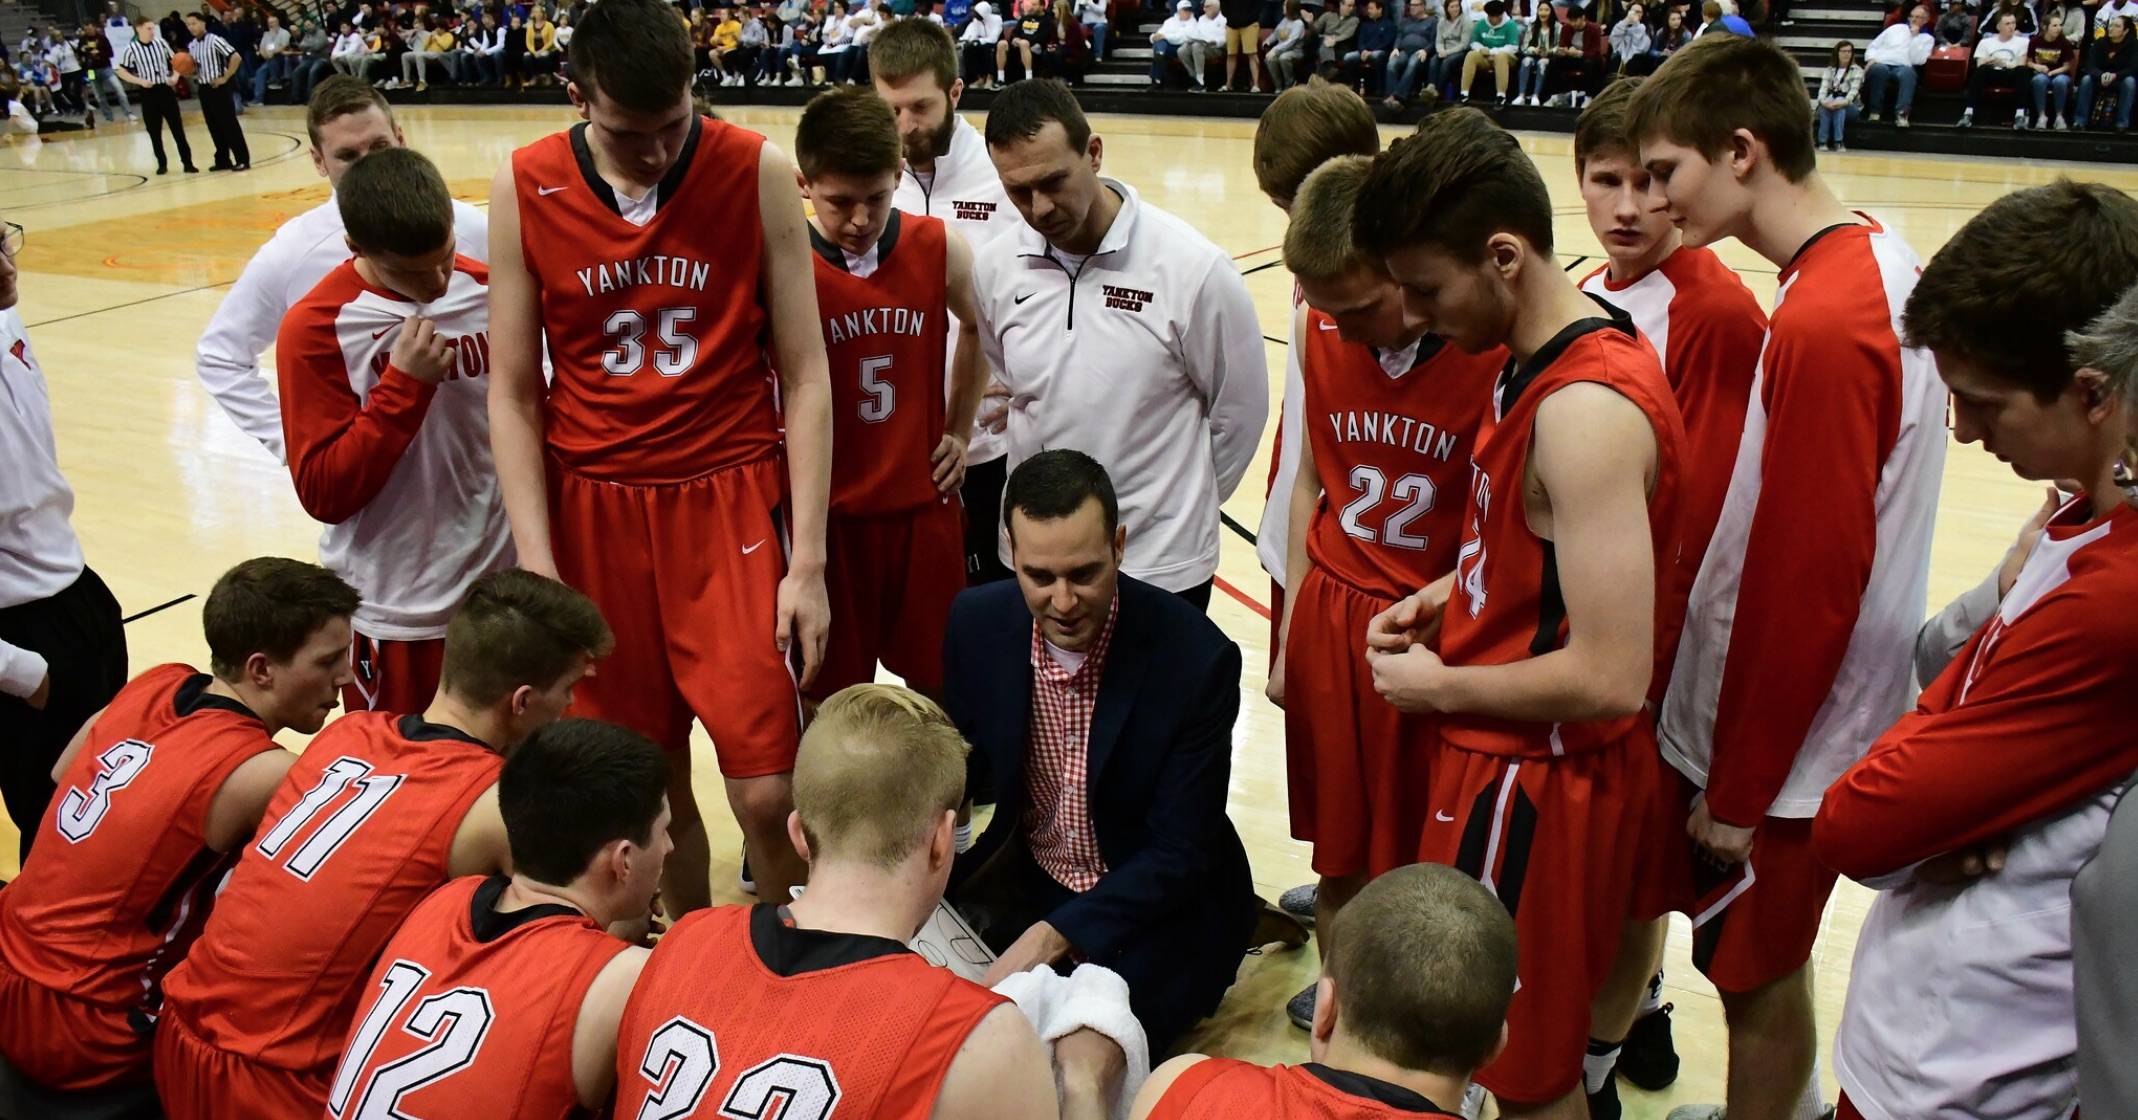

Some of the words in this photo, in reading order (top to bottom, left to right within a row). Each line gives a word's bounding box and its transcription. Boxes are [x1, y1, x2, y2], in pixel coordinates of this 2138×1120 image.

[952, 200, 997, 212] YANKTON
[576, 255, 710, 297] YANKTON
[1102, 284, 1154, 304] YANKTON
[601, 306, 699, 377] 35
[829, 307, 925, 344] ANKTON
[857, 353, 896, 424] 5
[1329, 410, 1457, 463] YANKTON
[1338, 463, 1438, 551] 22
[56, 738, 156, 845] 3
[255, 755, 409, 884] 11
[326, 958, 497, 1120] 12
